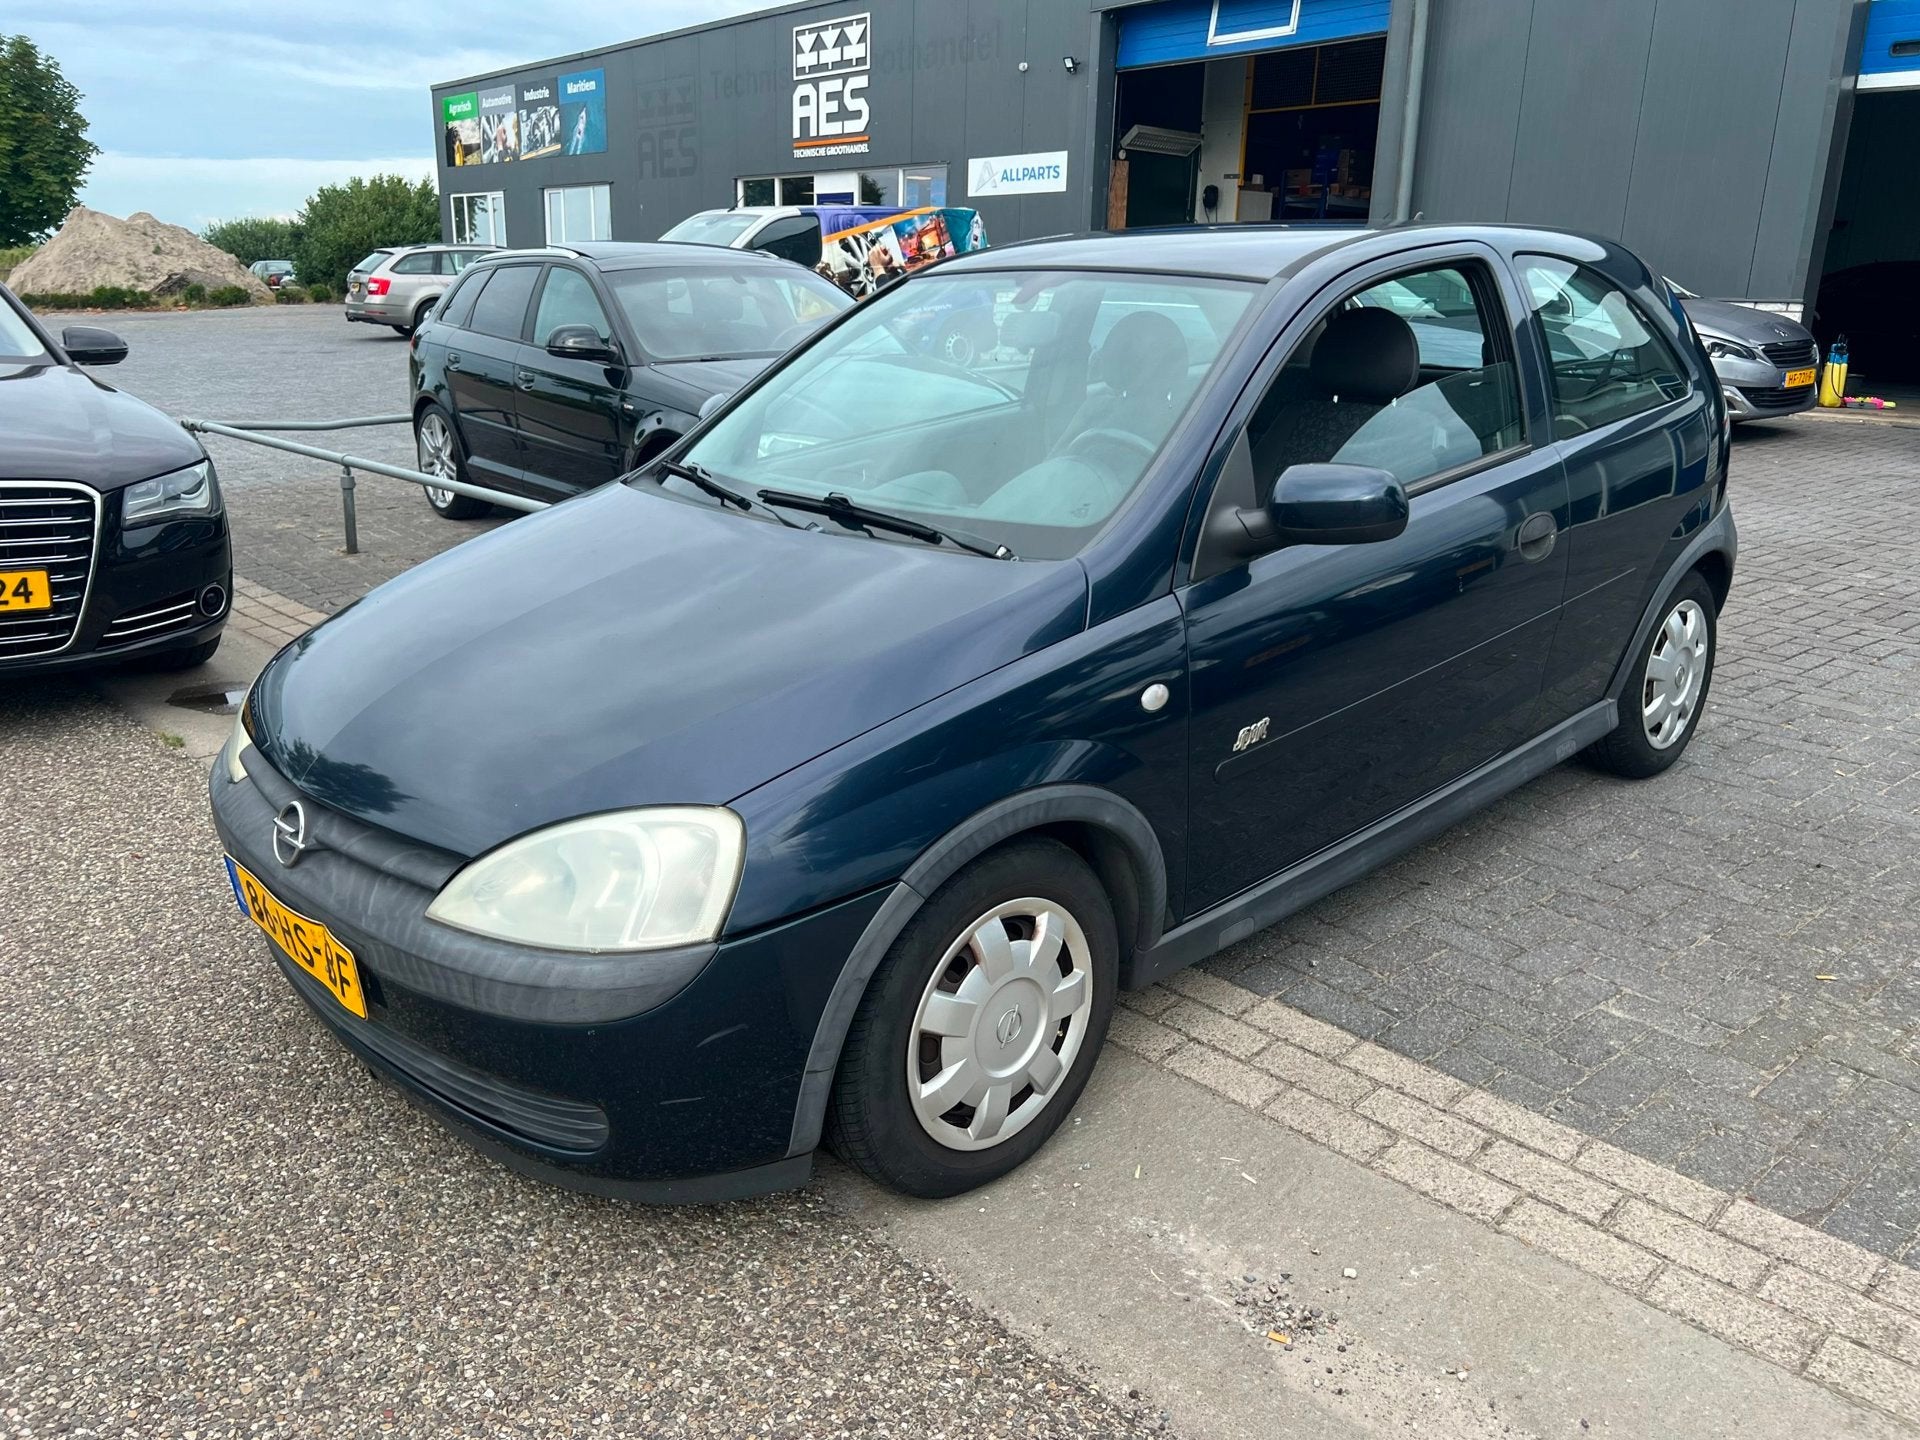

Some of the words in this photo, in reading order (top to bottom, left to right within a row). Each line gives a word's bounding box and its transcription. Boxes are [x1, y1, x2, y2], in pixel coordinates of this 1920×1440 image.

[523, 86, 550, 101] Industrie
[566, 80, 596, 94] Maritiem
[448, 101, 472, 116] Agrarisch
[482, 94, 513, 109] Automotive
[793, 75, 869, 138] AES
[793, 147, 826, 158] TECHNISCHE
[826, 144, 869, 156] GROOTHANDEL
[1001, 165, 1060, 182] ALLPARTS
